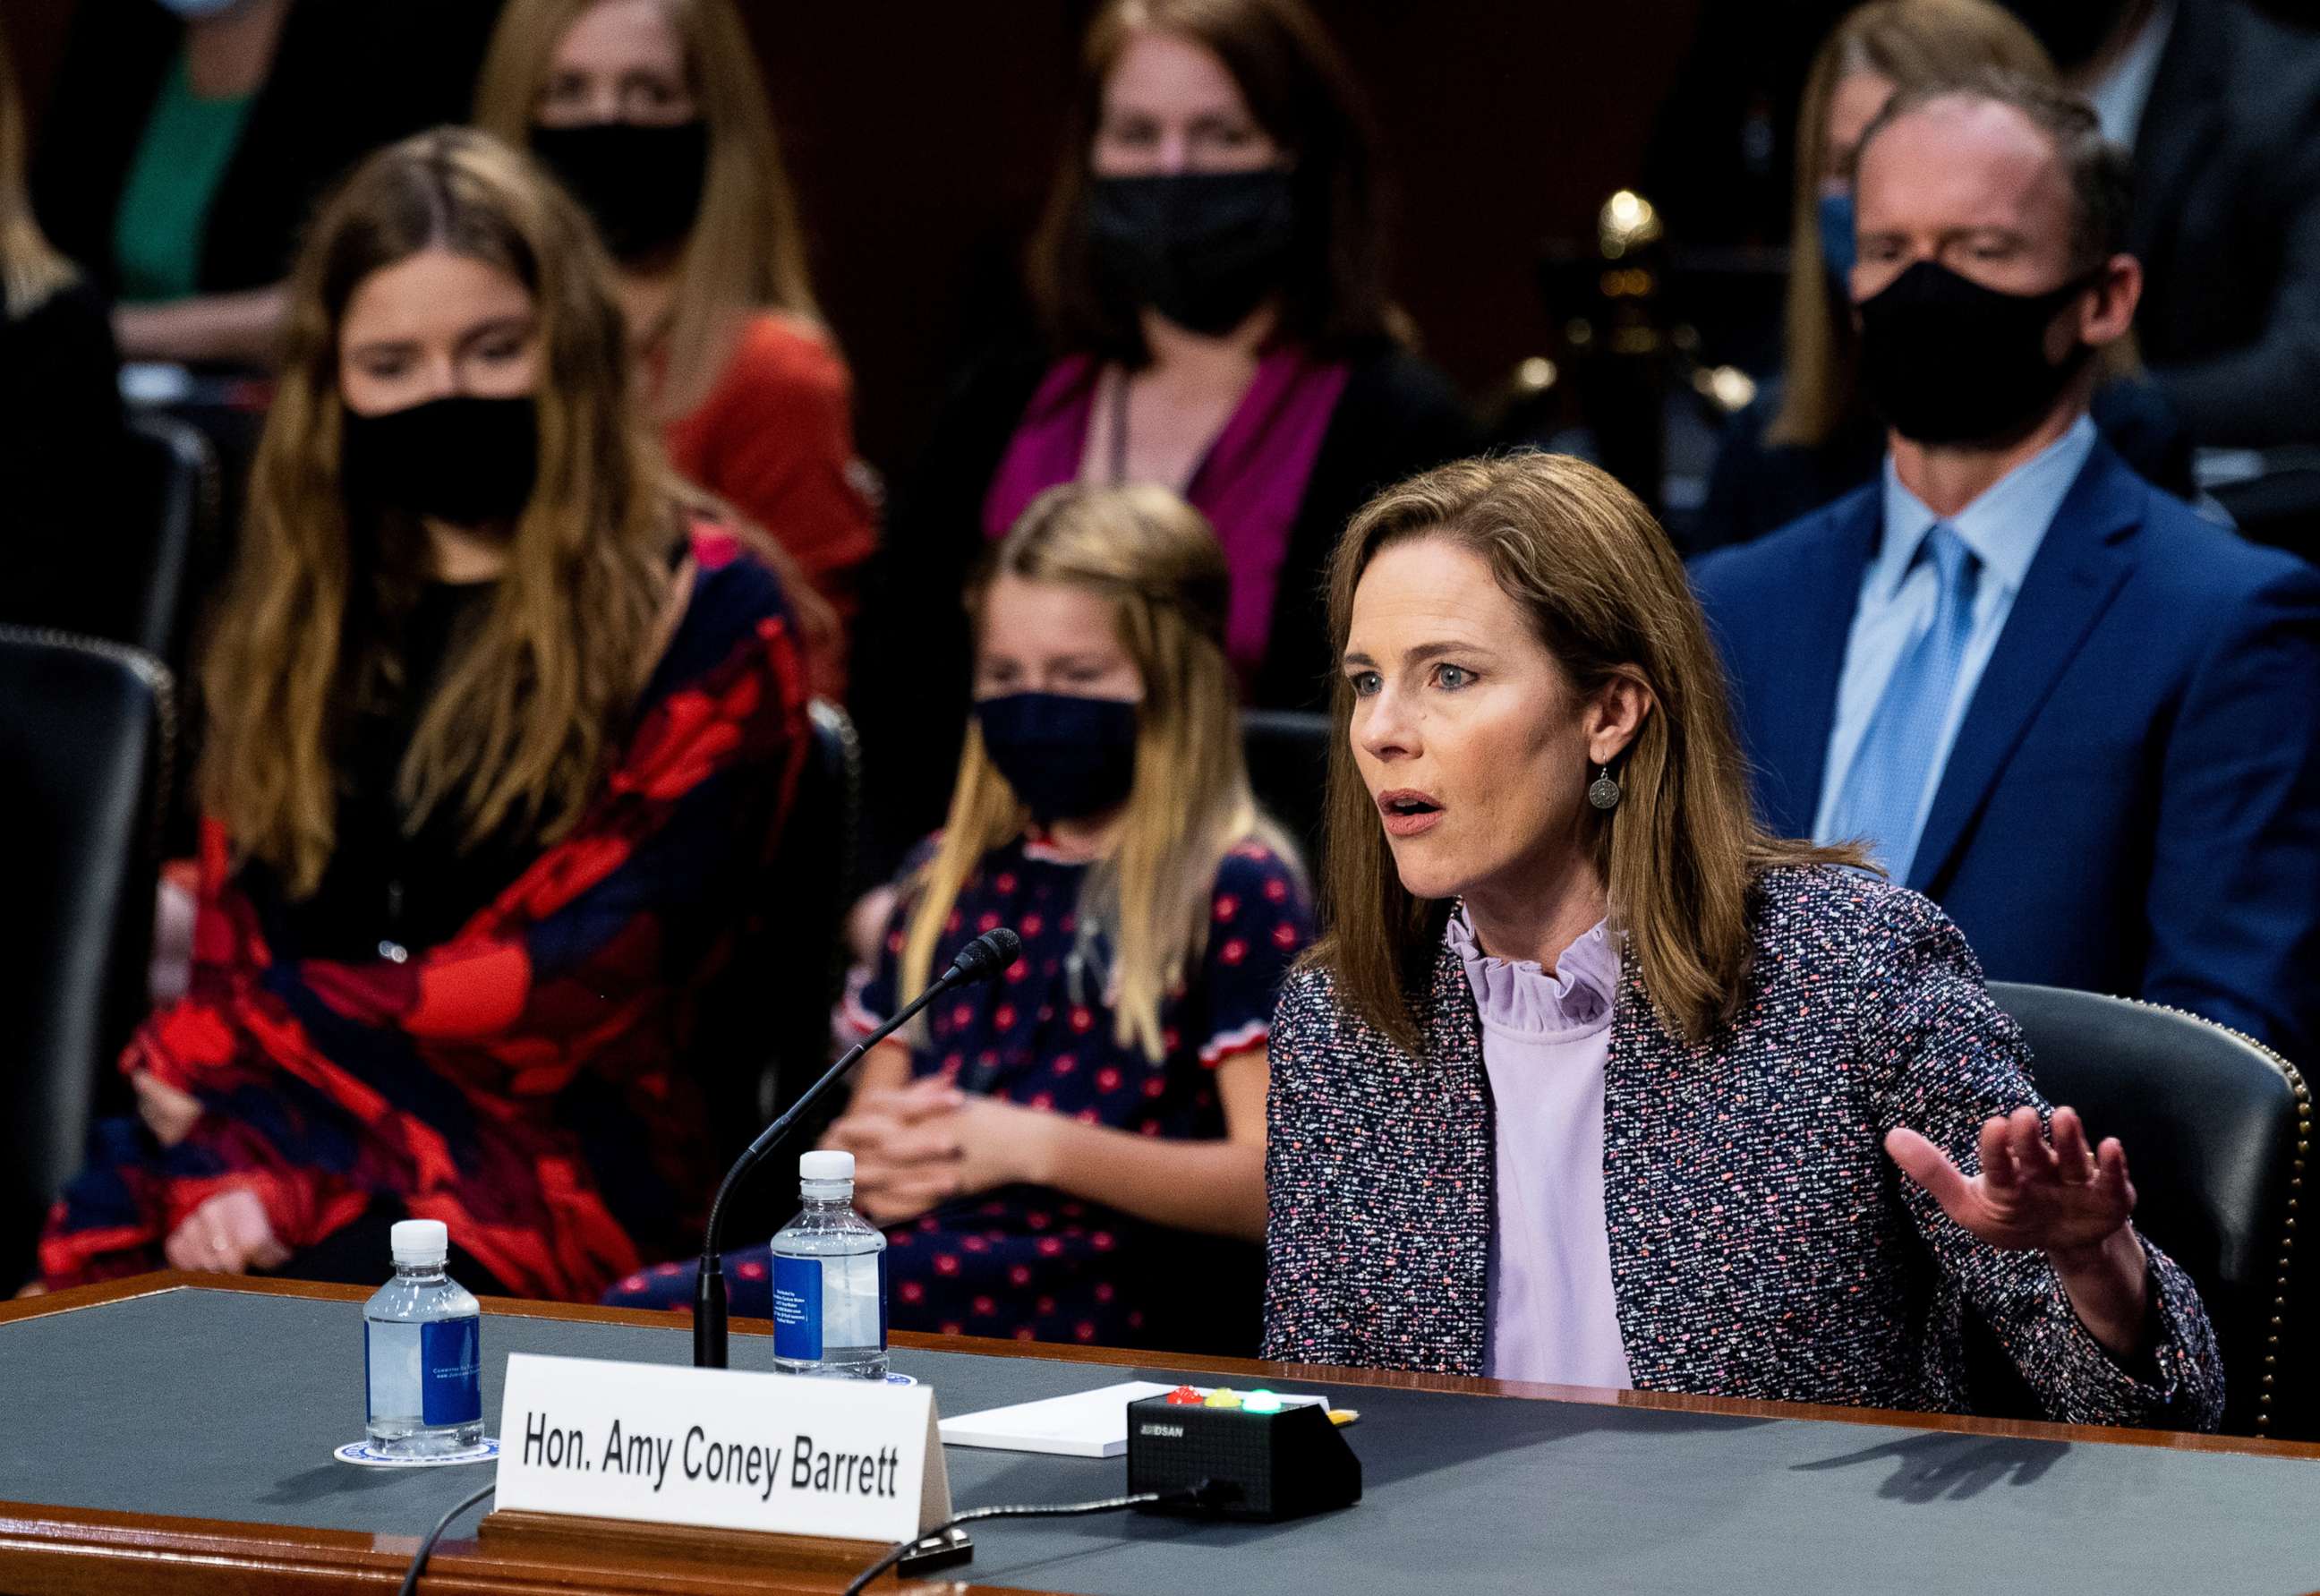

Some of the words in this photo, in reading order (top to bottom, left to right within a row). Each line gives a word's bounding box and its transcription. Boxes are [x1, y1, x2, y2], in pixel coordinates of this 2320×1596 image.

[524, 1412, 590, 1471] Hon.
[602, 1419, 673, 1492] Amy
[683, 1425, 781, 1501] Coney
[791, 1435, 898, 1498] Barrett
